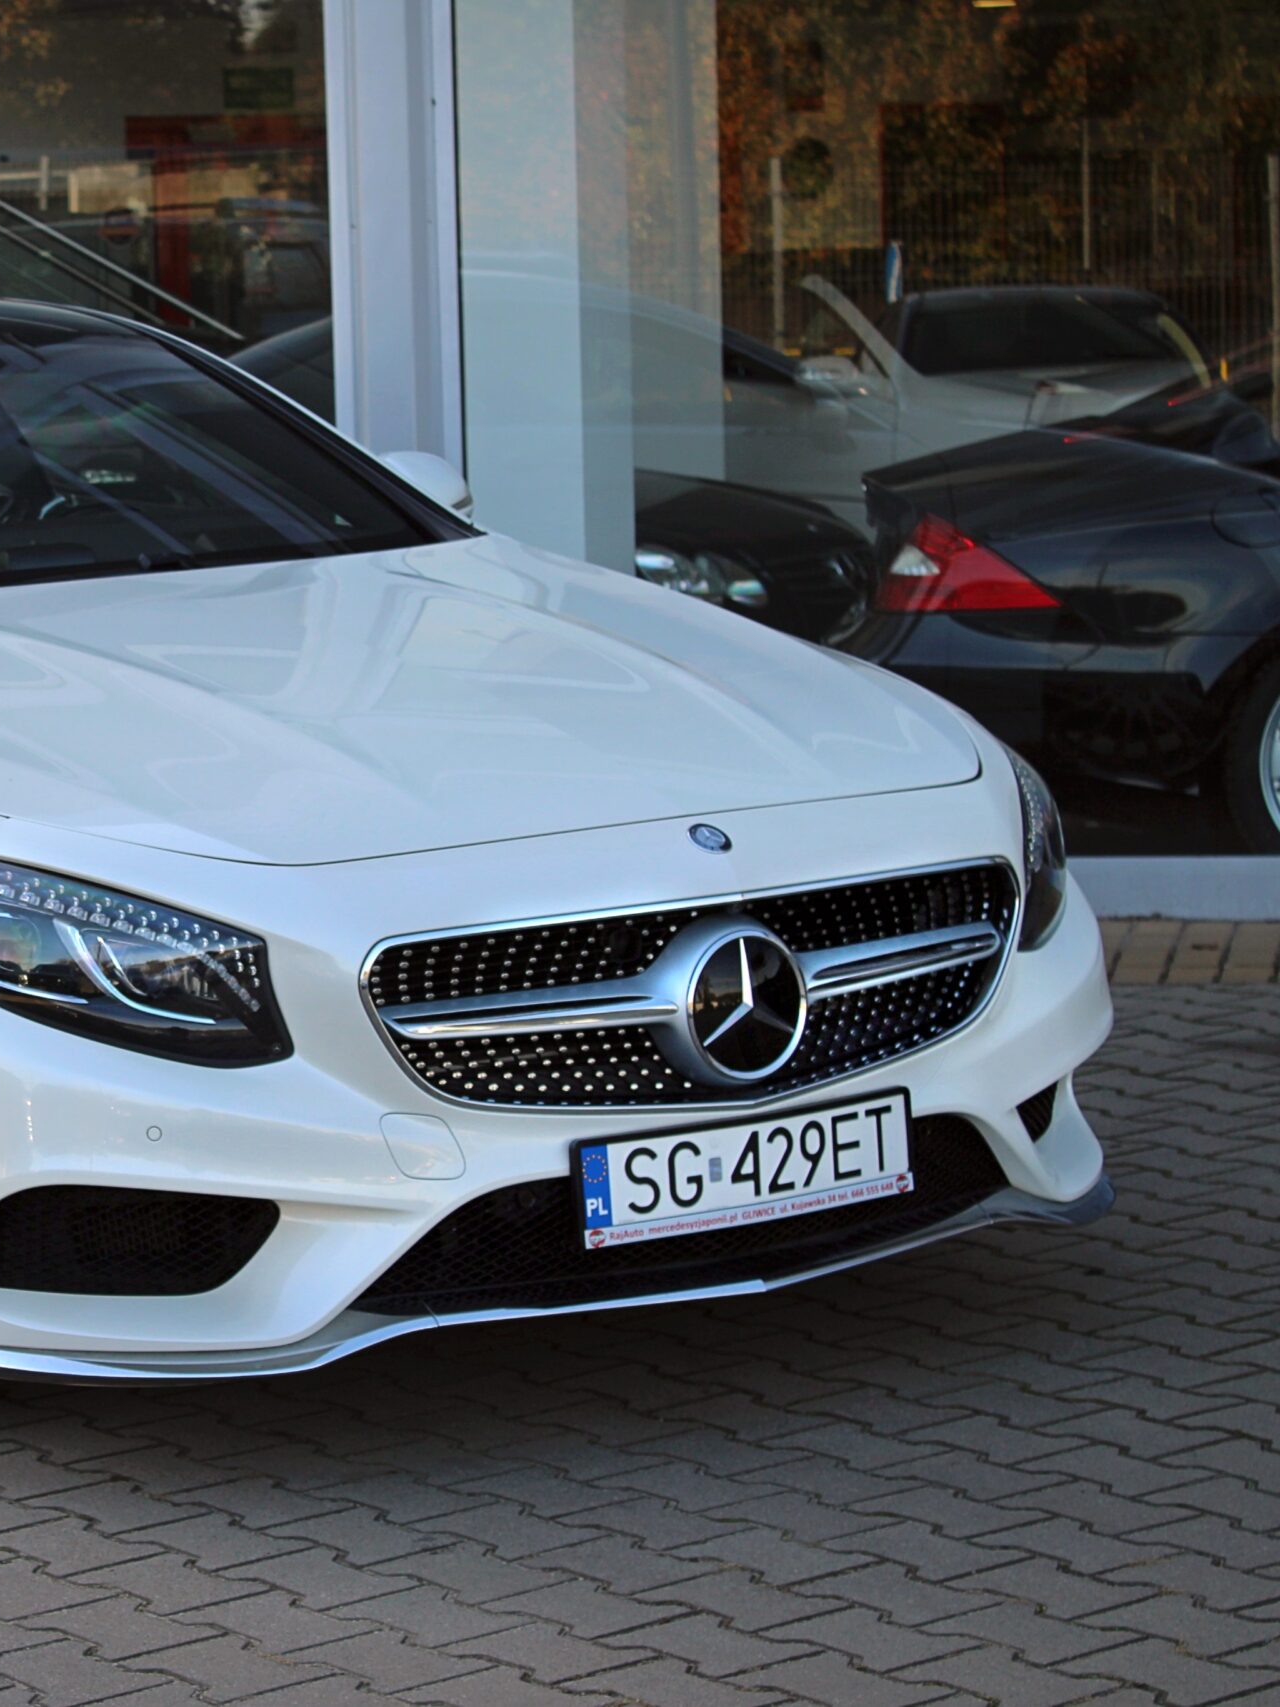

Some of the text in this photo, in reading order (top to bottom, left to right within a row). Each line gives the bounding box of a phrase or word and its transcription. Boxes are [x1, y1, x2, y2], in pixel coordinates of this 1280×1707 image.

[624, 1105, 892, 1214] SG 429ET
[585, 1197, 609, 1218] PL
[742, 1206, 776, 1220] GLIWICE
